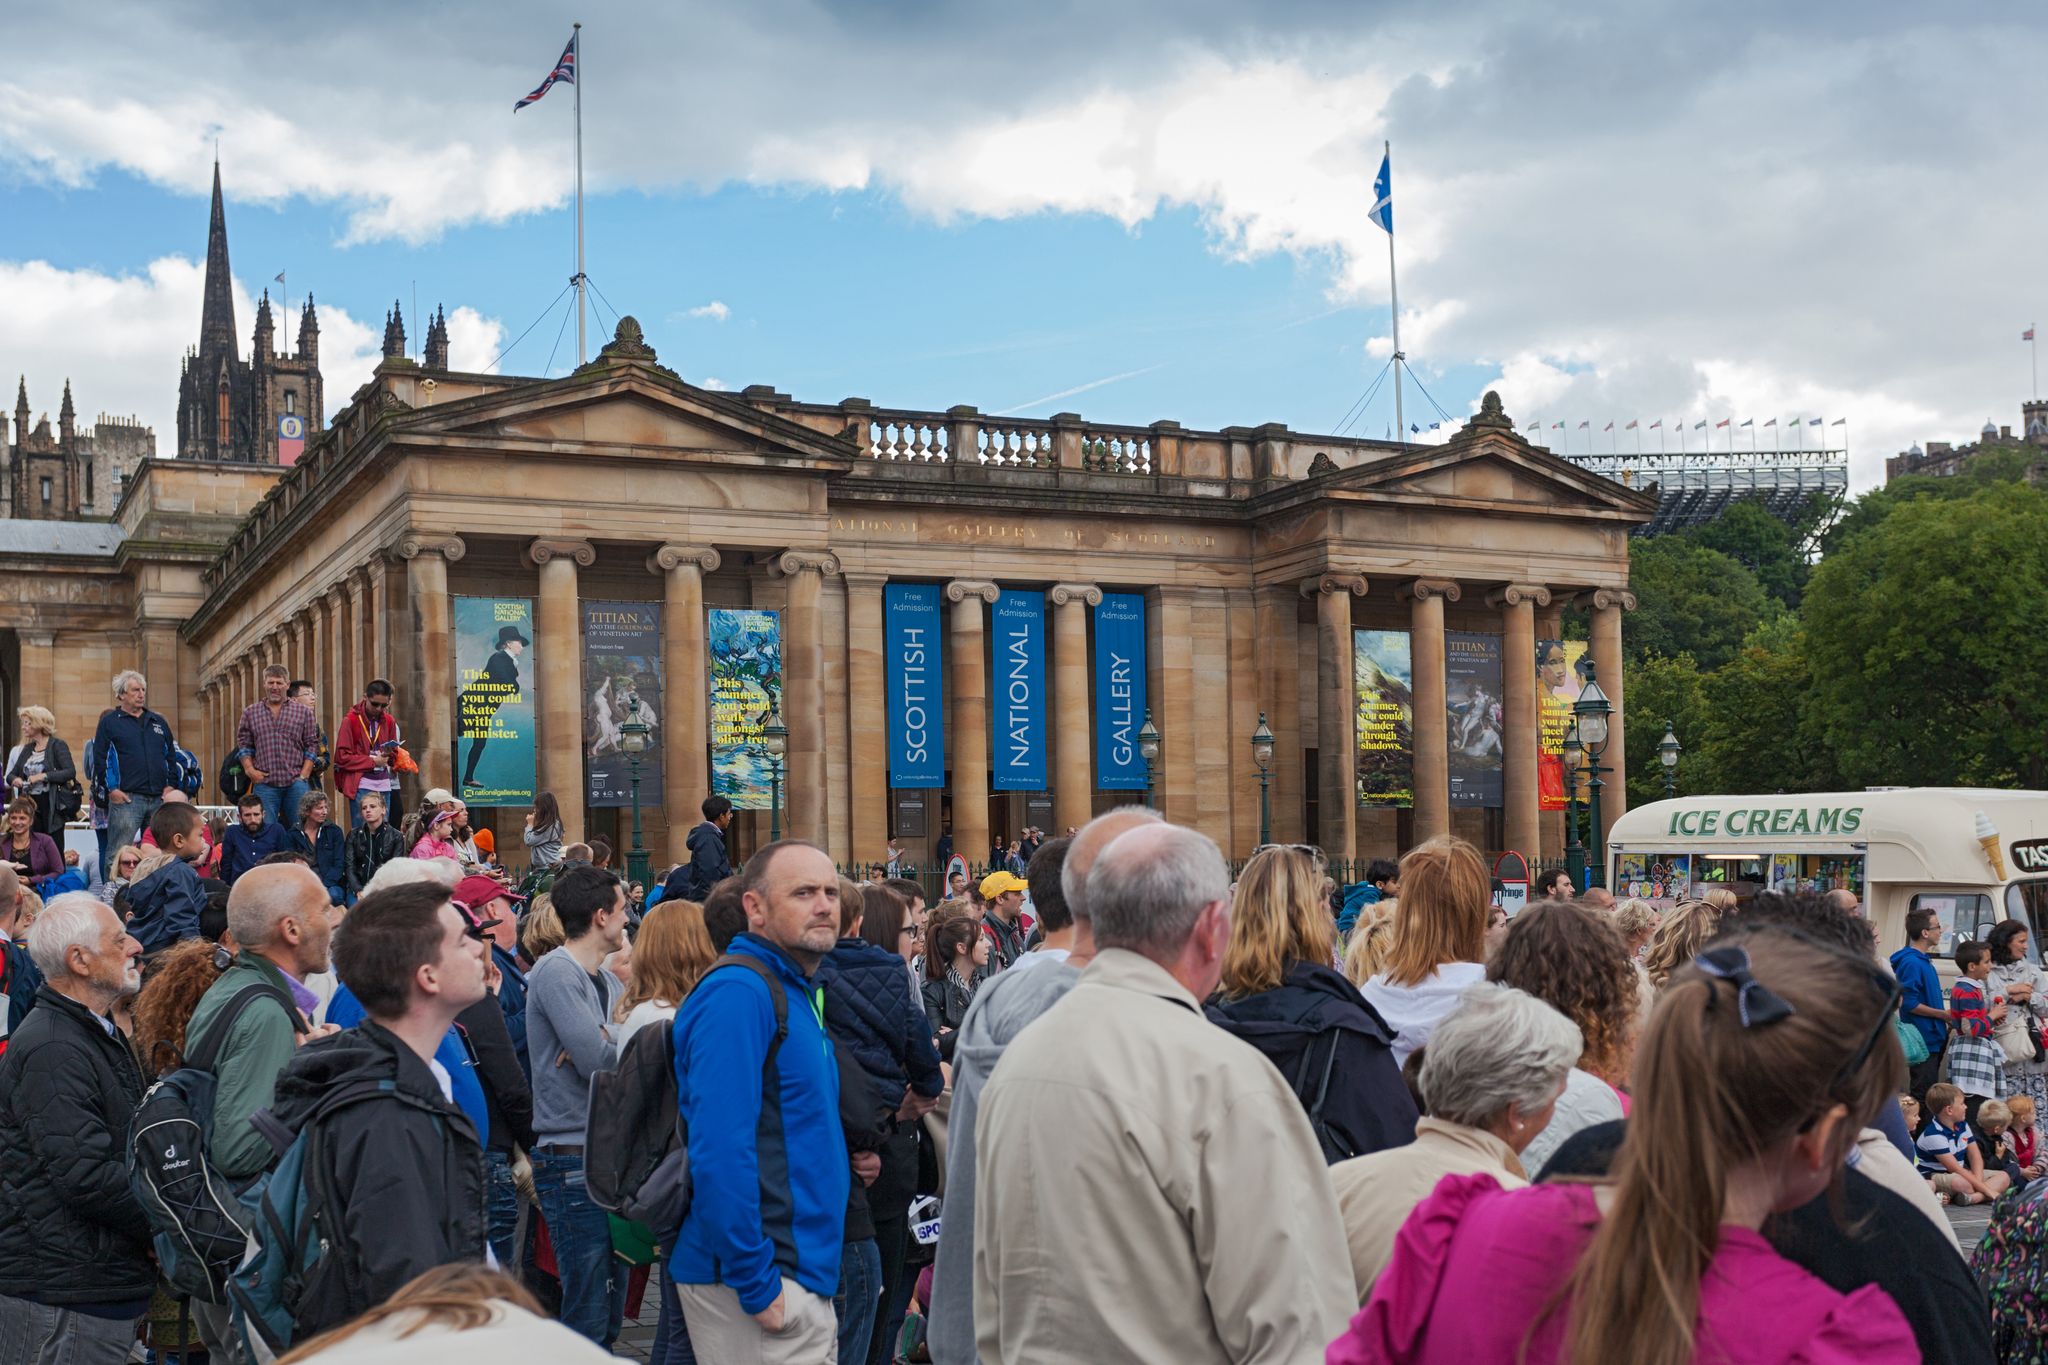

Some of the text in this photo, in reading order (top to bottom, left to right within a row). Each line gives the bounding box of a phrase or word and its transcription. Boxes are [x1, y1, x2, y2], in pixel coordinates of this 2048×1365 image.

[828, 519, 1215, 547] ATIONAL GALLERY OF SCOTLAND
[905, 593, 921, 601] Free
[894, 603, 933, 612] Admission
[1010, 599, 1026, 607] Free
[1112, 602, 1128, 610] Free
[589, 612, 638, 624] TITIAN
[999, 609, 1038, 618] Admission
[1102, 612, 1138, 620] Admission
[1450, 642, 1486, 651] TITIAN
[462, 669, 490, 680] This
[462, 683, 515, 692] summer,
[717, 678, 741, 688] This
[462, 693, 522, 705] you could
[716, 690, 764, 699] summer,
[904, 628, 927, 763] SCOTTISH
[1009, 624, 1030, 766] NATIONAL
[1361, 690, 1380, 699] This
[716, 700, 770, 711] you could
[1360, 702, 1398, 710] summer,
[1541, 698, 1560, 706] This
[463, 704, 496, 714] skate
[1110, 652, 1132, 766] GALLERY
[463, 716, 504, 726] with a
[716, 711, 745, 722] walk
[1360, 711, 1402, 722] you could
[1360, 721, 1395, 730] wander
[1541, 718, 1558, 728] you
[463, 728, 518, 738] minister.
[717, 724, 765, 734] amongst
[717, 734, 744, 744] olive
[1361, 731, 1396, 742] through
[1361, 740, 1402, 750] shadows.
[474, 789, 531, 797] nationalgalleries.org
[1668, 808, 1864, 837] ICE CREAMS
[1504, 888, 1523, 898] ringe
[162, 1160, 190, 1170] deuter
